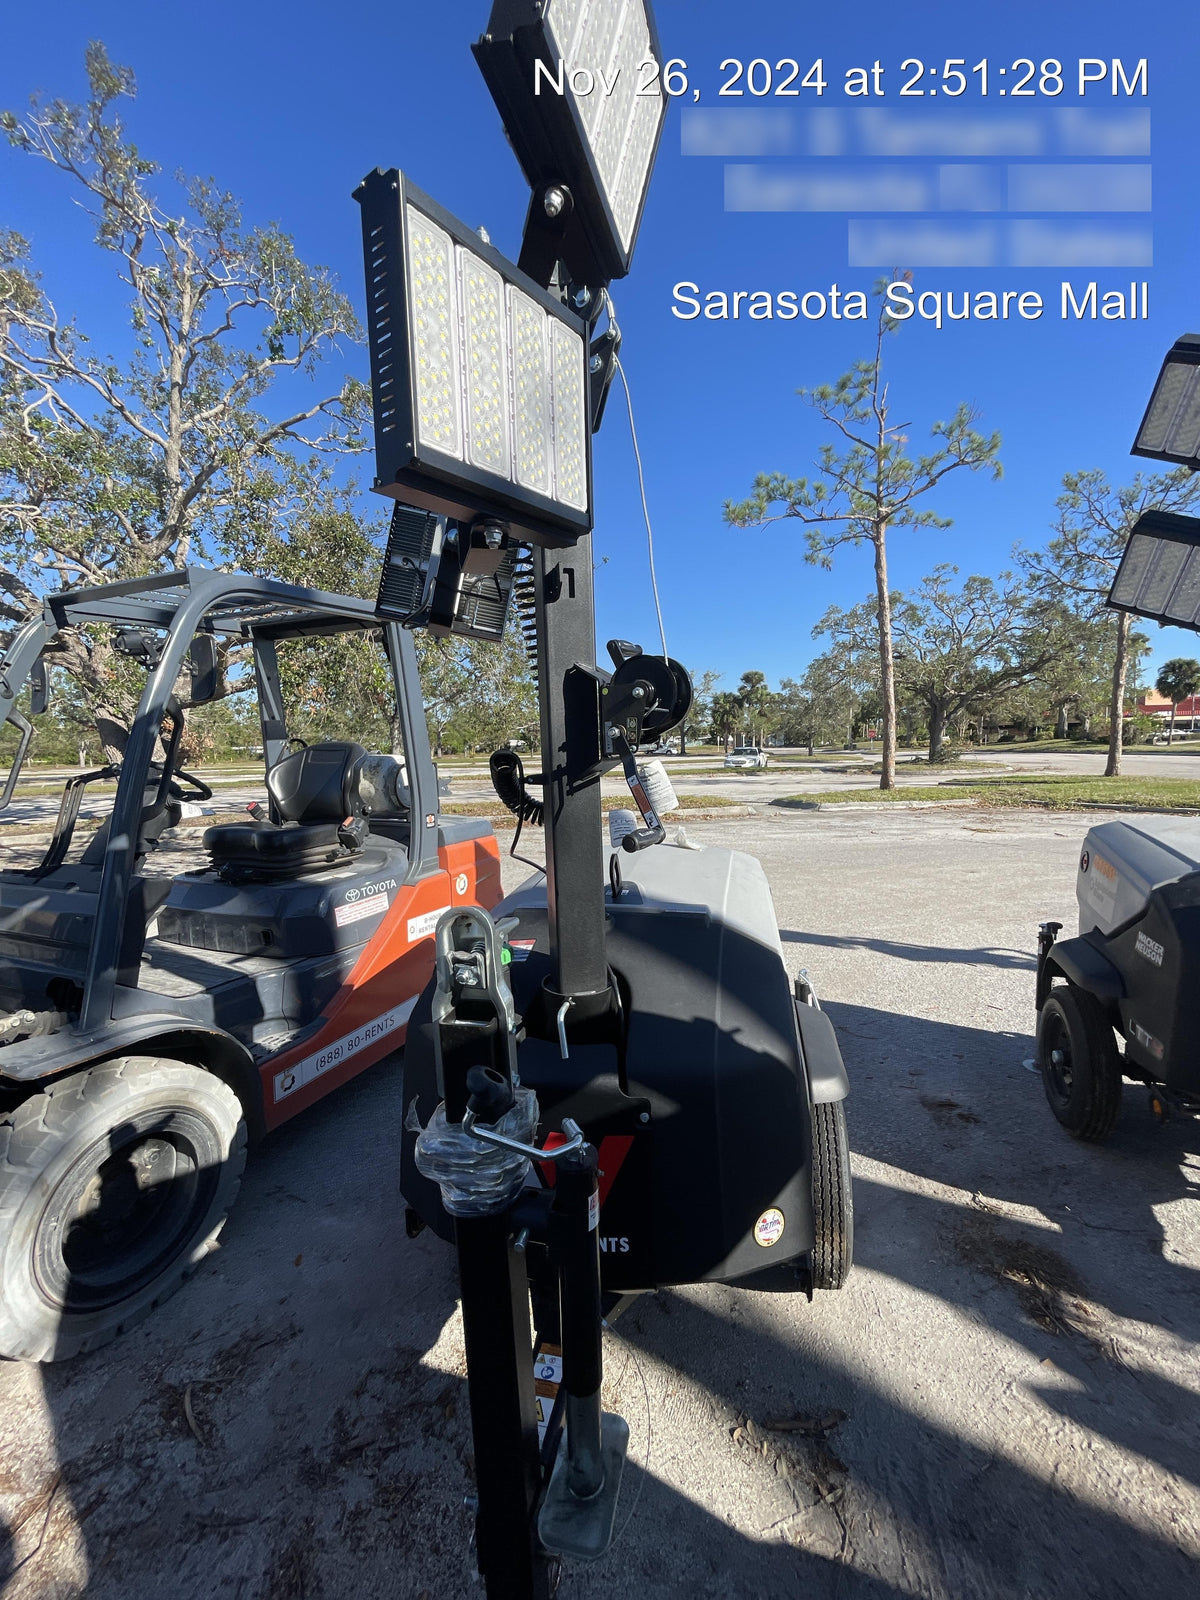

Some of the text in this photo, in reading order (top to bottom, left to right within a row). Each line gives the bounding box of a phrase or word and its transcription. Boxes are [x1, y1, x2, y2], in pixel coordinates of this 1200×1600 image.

[360, 879, 398, 897] TOYOTA
[1135, 940, 1164, 967] NEUSON
[1138, 930, 1165, 956] WACKER
[315, 1014, 396, 1072] (888) 80-RENTS
